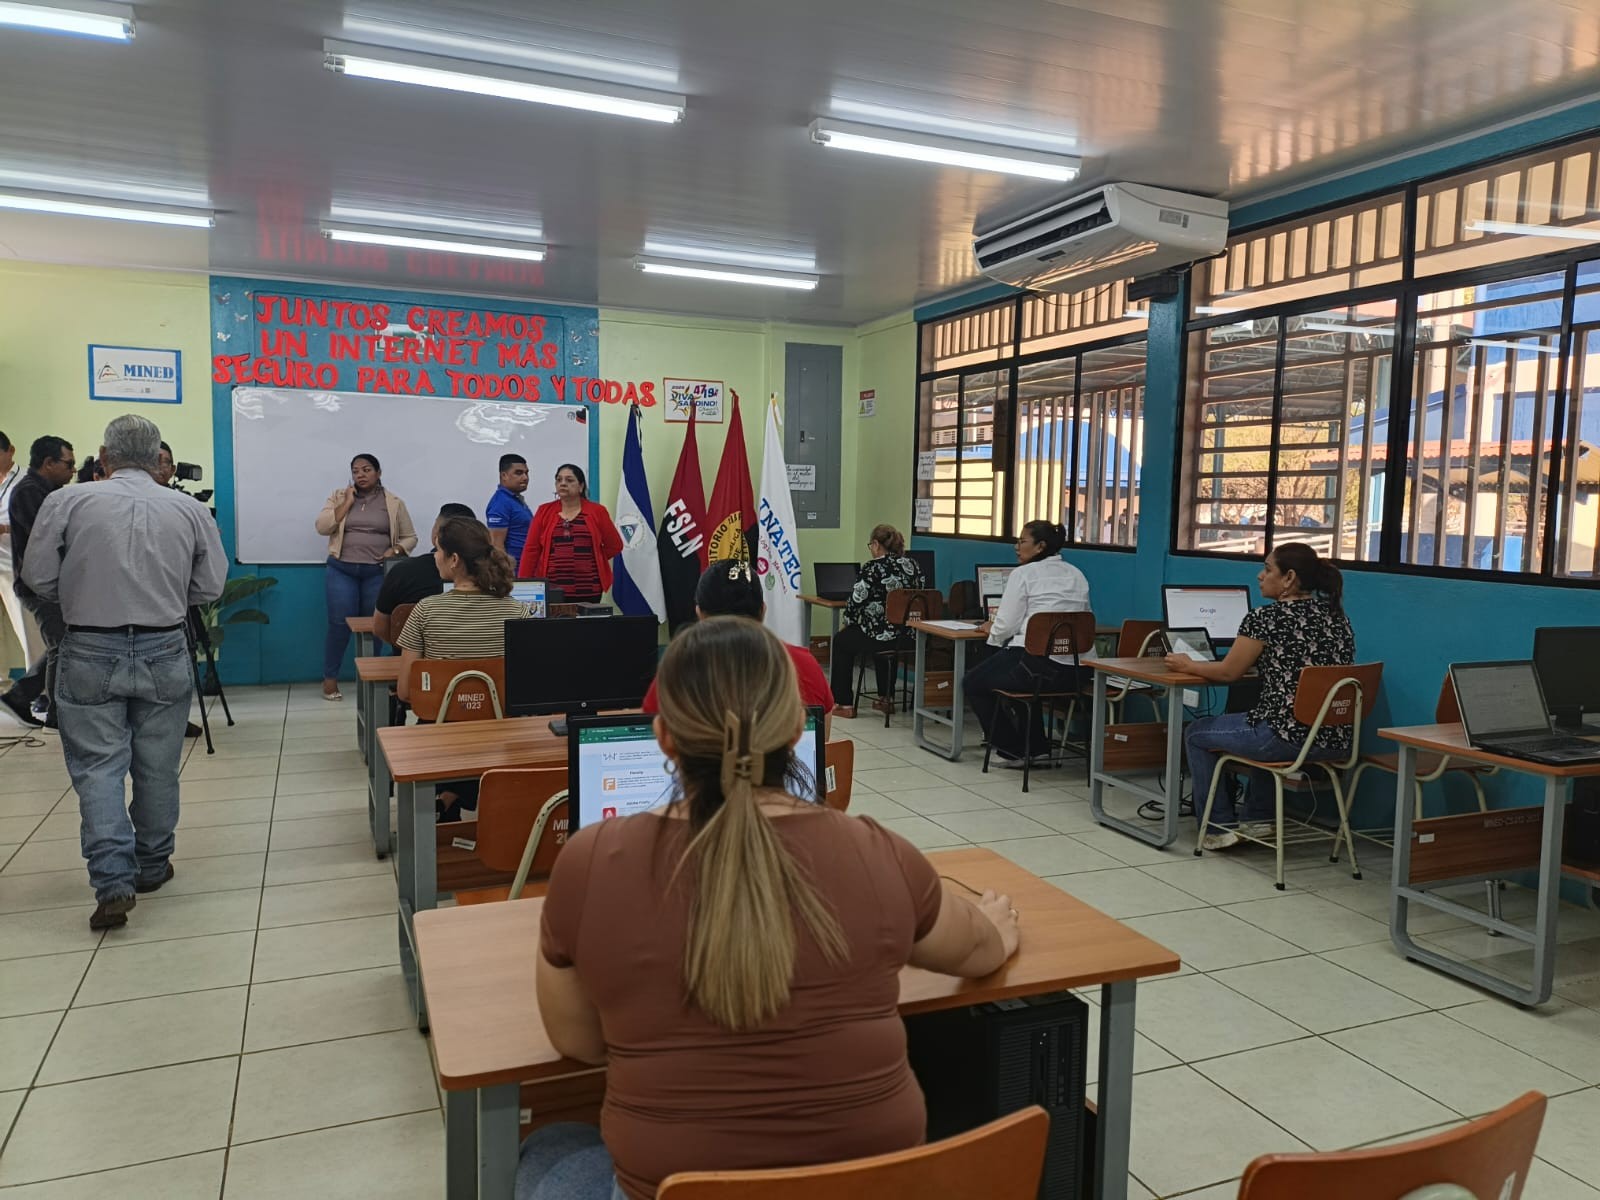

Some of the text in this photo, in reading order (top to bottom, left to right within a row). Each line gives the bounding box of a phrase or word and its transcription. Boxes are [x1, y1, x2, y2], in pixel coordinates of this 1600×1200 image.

[256, 294, 546, 341] JUNTOS CREAMOS
[260, 328, 308, 358] UN
[329, 331, 485, 367] INTERNET
[123, 363, 174, 379] MINED
[212, 353, 656, 407] SEGURO PARA TODOS Y TODAS
[671, 393, 695, 401] VIVA
[663, 498, 704, 559] FSLN
[457, 693, 485, 702] MINED
